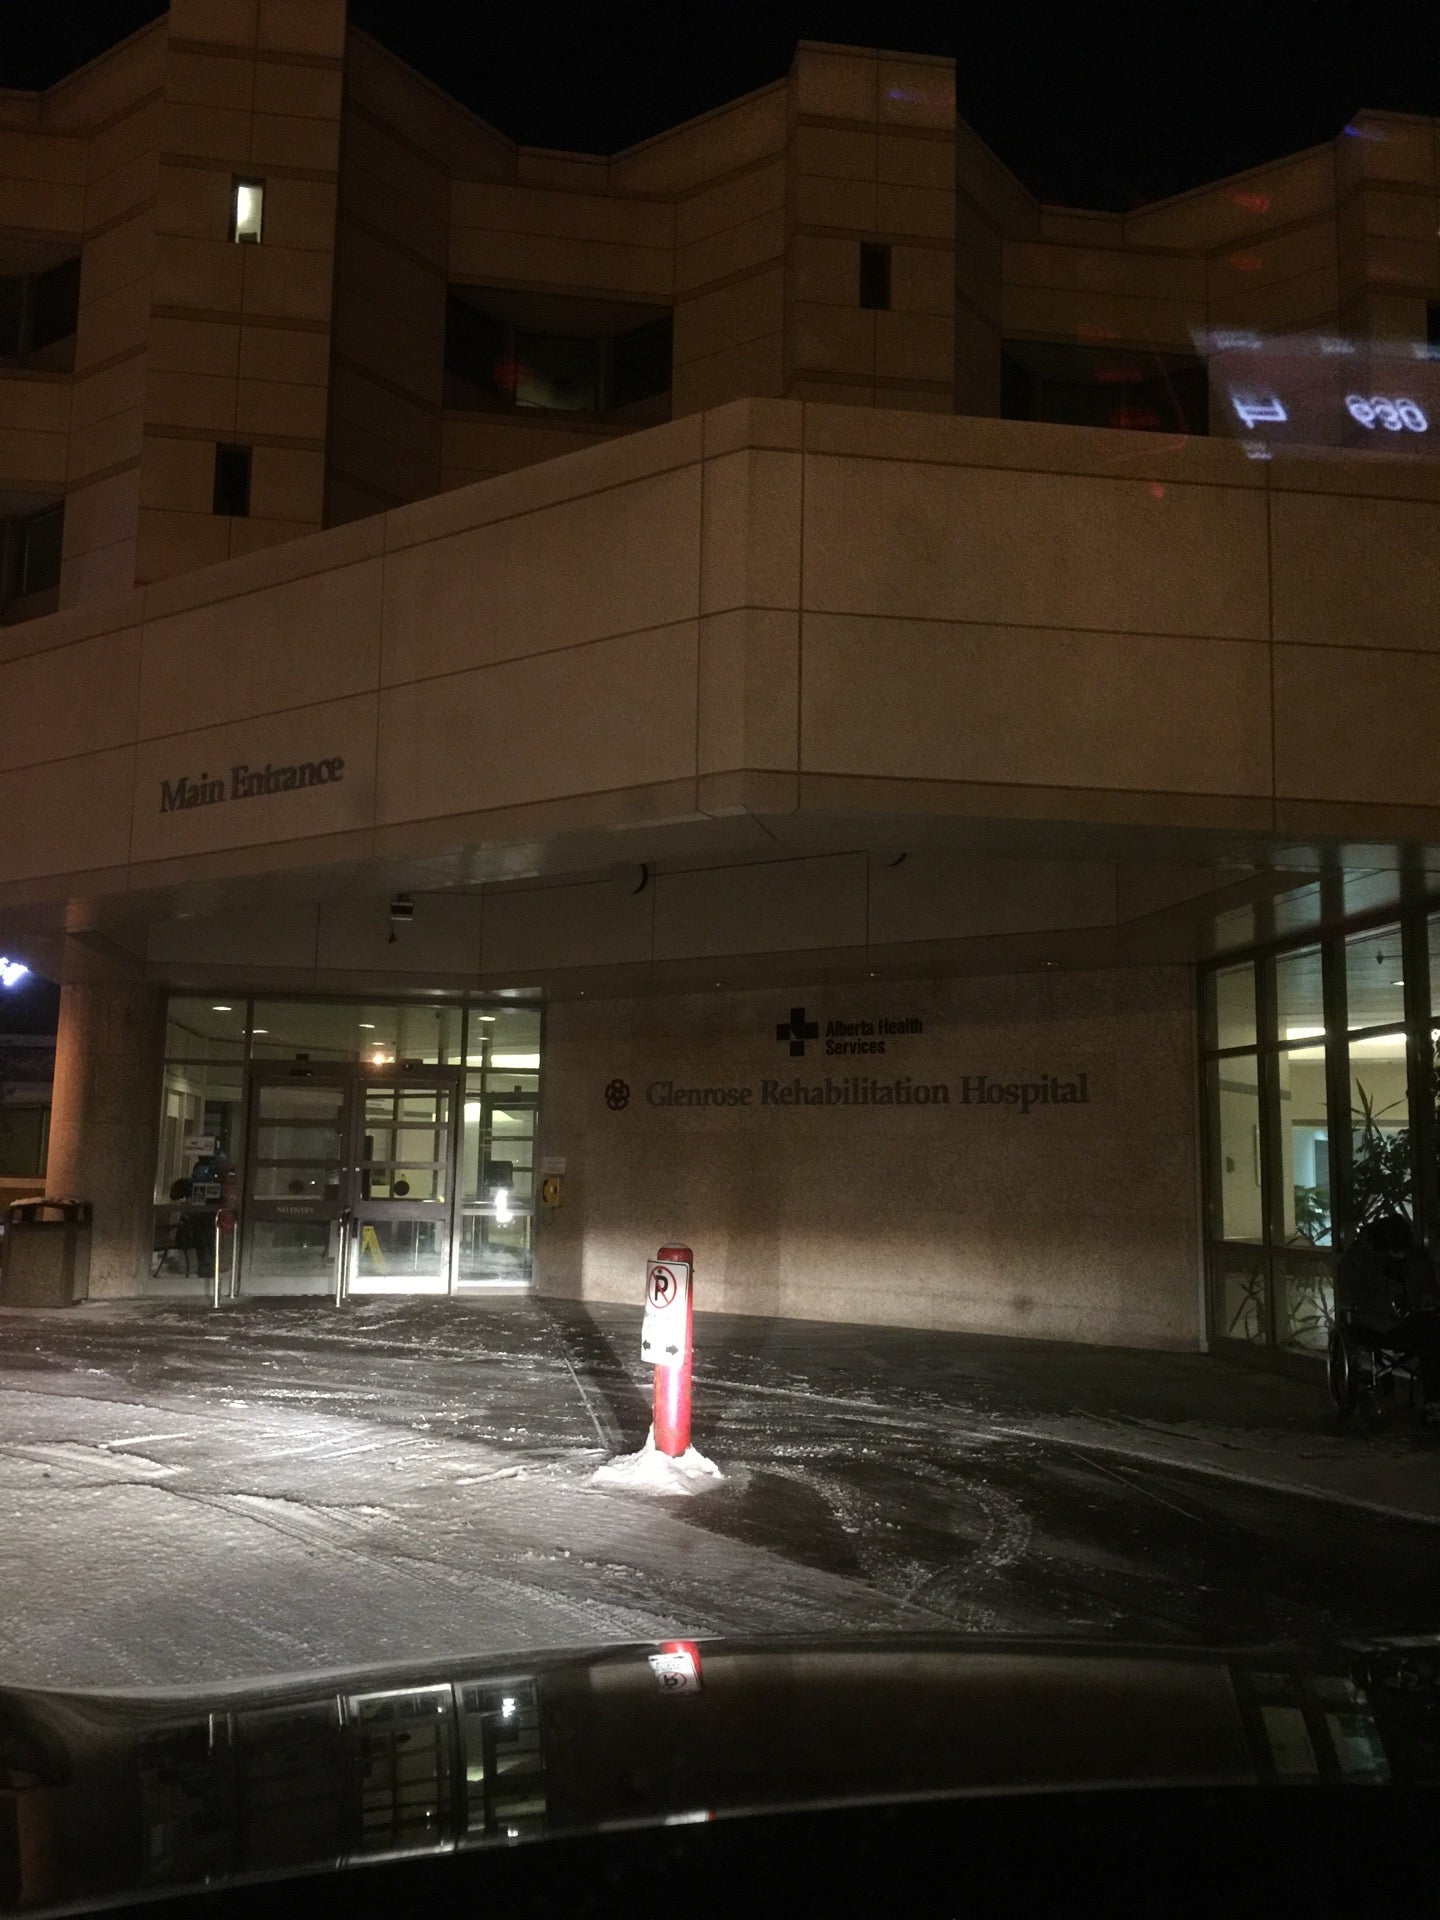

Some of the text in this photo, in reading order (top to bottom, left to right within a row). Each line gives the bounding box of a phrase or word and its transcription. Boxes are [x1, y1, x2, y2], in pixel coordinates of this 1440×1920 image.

[160, 757, 345, 813] Main Entrance
[825, 1017, 923, 1037] Alberta Health
[825, 1038, 886, 1056] Services
[646, 1073, 1090, 1114] Glenrose Rehabilitation Hospital
